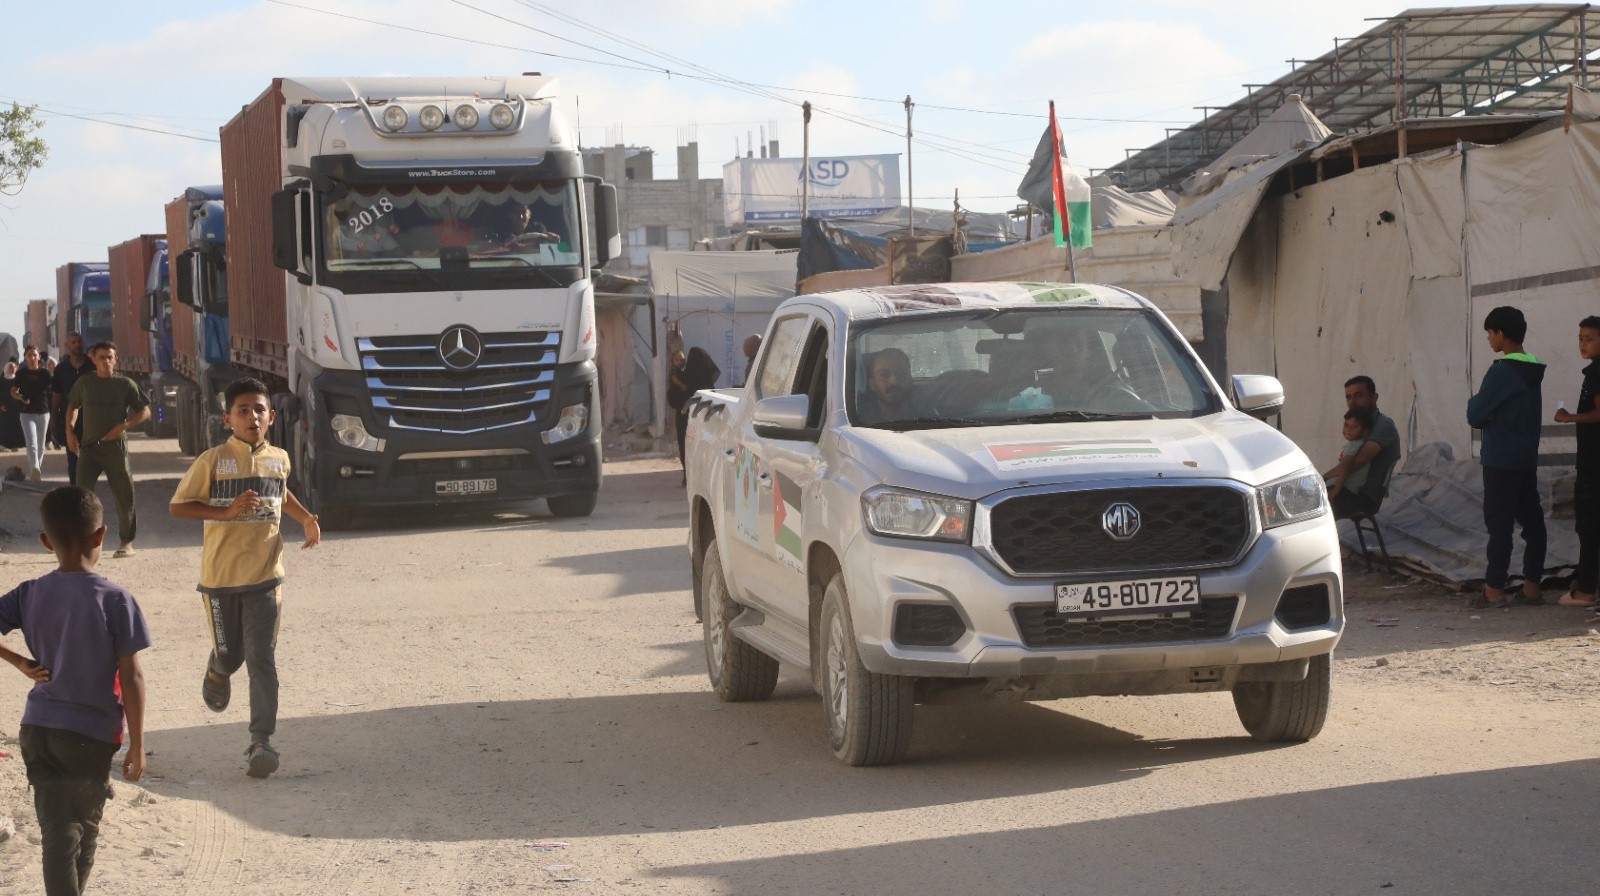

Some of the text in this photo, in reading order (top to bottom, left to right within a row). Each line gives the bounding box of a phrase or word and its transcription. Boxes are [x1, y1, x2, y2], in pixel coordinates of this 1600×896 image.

[408, 169, 496, 177] www.TruckStore.com
[798, 160, 849, 181] ASD
[349, 197, 393, 234] 2018
[1107, 504, 1138, 536] MG
[1083, 580, 1195, 608] 49-80722
